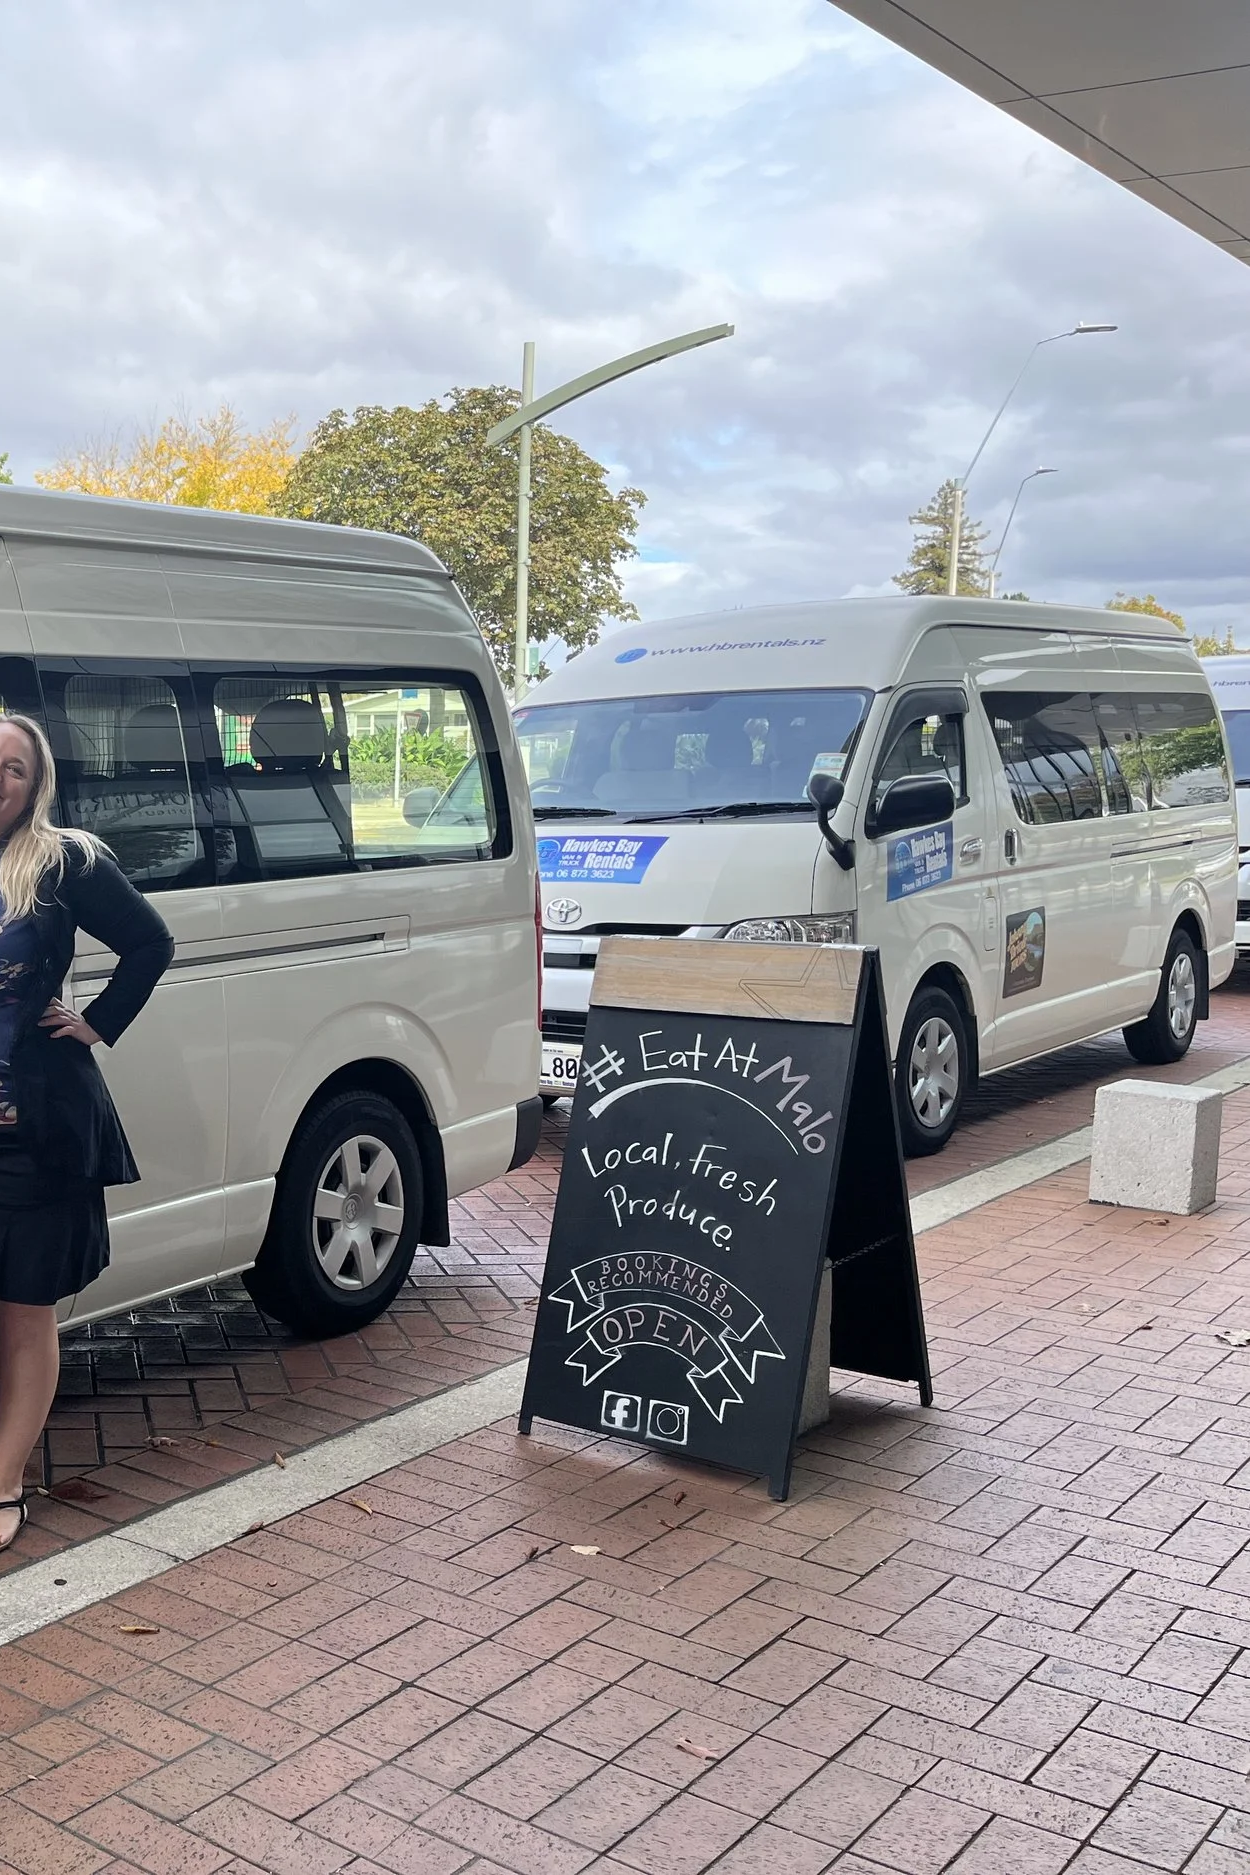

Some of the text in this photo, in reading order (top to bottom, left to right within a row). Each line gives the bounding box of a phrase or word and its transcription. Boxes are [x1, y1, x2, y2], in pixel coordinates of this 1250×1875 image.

[651, 638, 827, 656] www.hbrentals.nz
[561, 839, 643, 855] Hawkes Bay
[583, 852, 636, 870] Rentals
[539, 869, 614, 879] one 06 873 3623
[581, 1131, 778, 1216] Local, Fresh
[603, 1184, 733, 1252] Produce.
[587, 1270, 733, 1319] RECOMMENDED
[601, 1255, 728, 1299] BOOKINGS
[602, 1308, 708, 1356] OPEN
